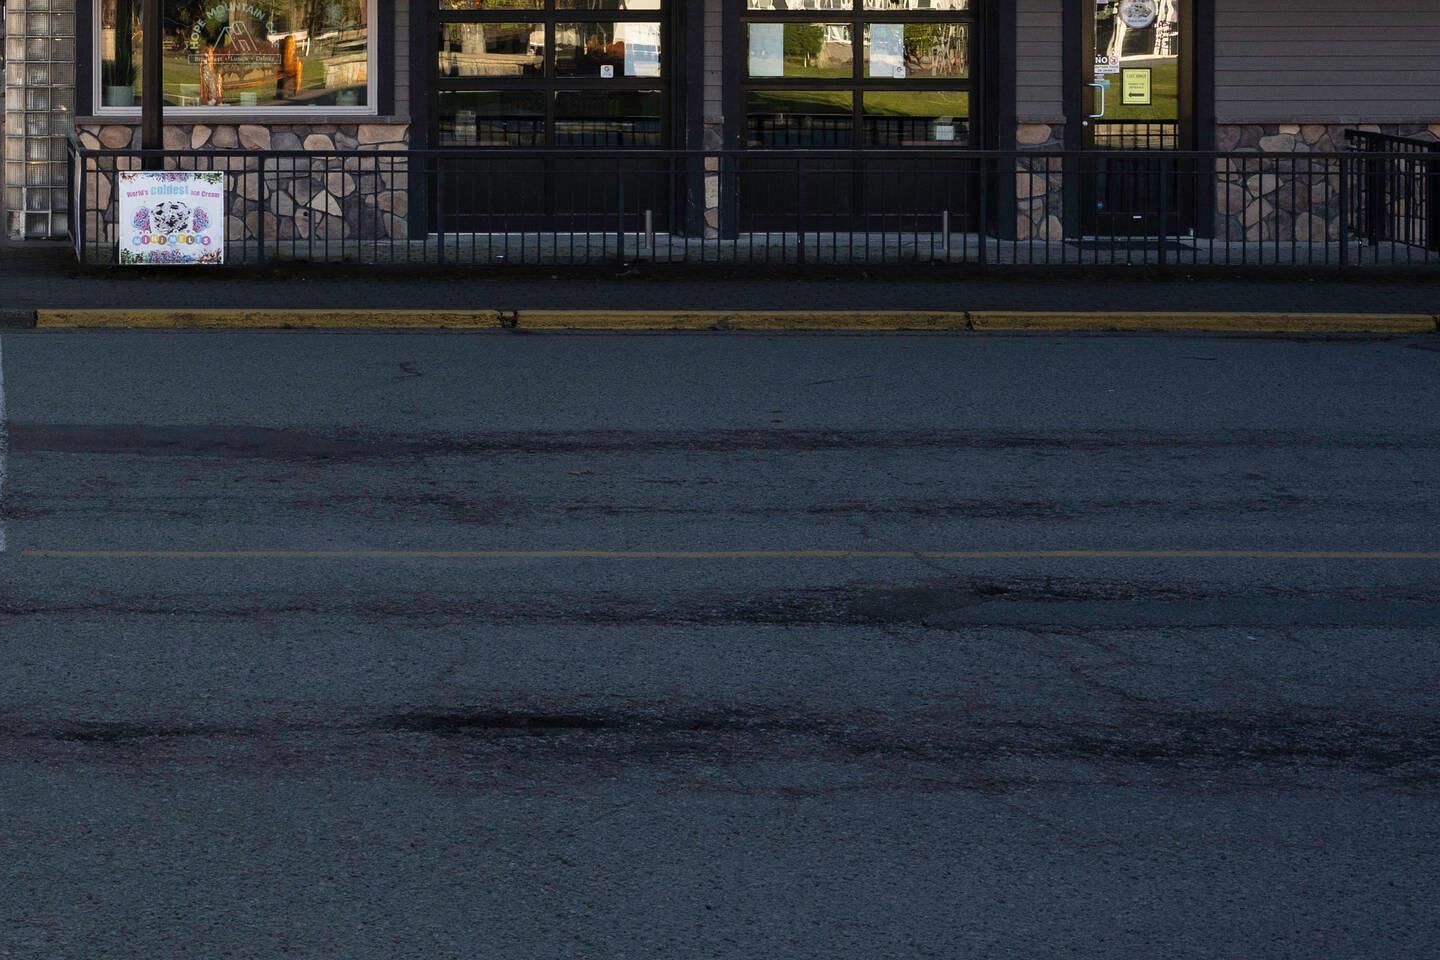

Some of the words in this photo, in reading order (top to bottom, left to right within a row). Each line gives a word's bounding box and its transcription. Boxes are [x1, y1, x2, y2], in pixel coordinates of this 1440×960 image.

[190, 19, 207, 49] HOPE
[206, 2, 266, 21] MOUNTAIN
[1095, 56, 1108, 64] NO
[150, 184, 189, 195] coldest
